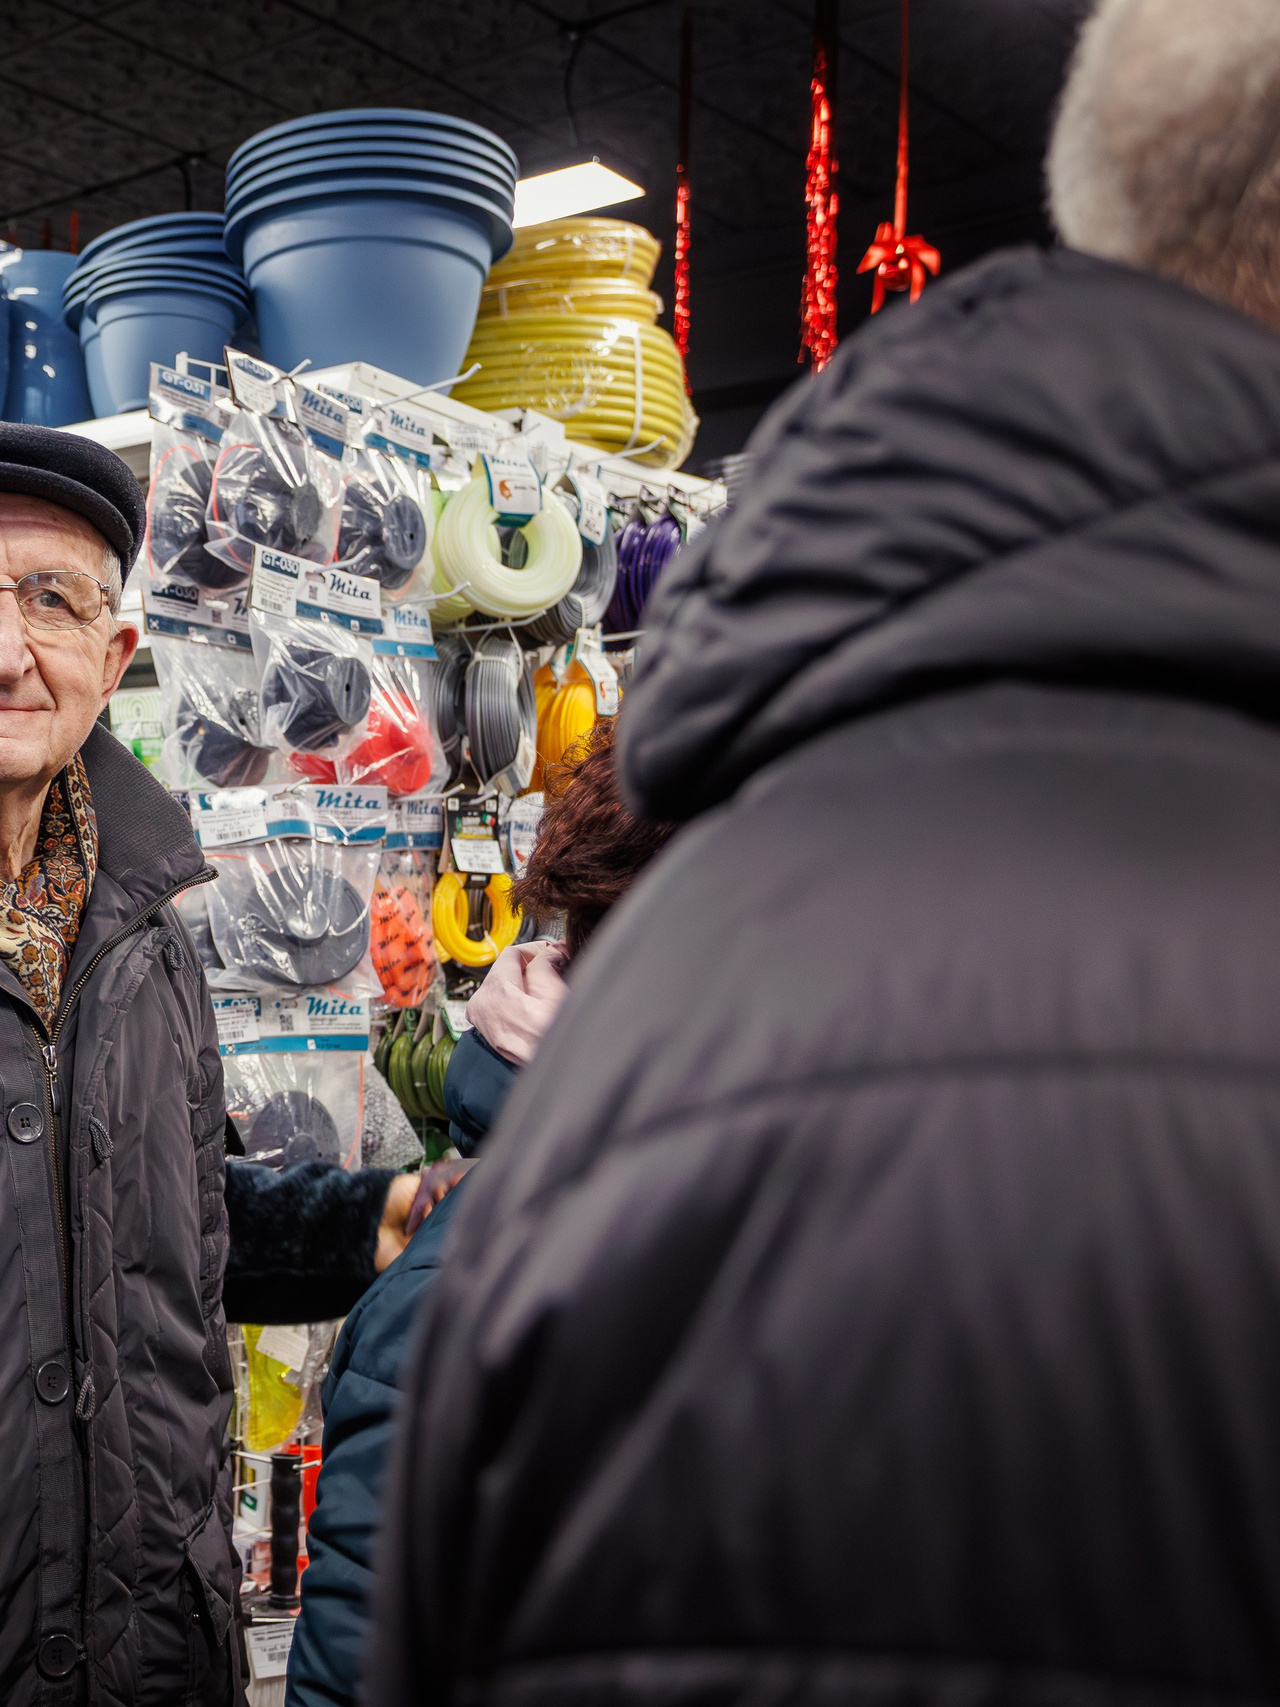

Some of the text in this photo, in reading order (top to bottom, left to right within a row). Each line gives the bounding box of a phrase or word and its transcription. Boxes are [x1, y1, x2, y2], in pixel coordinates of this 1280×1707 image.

[162, 371, 205, 395] GT-031
[300, 388, 344, 424] Mita
[390, 410, 426, 437] Mita
[262, 552, 299, 575] GT-030
[330, 573, 372, 600] Mita
[394, 606, 428, 628] Mita
[315, 790, 381, 809] Mita
[407, 800, 440, 815] Mita
[306, 996, 364, 1016] Mita
